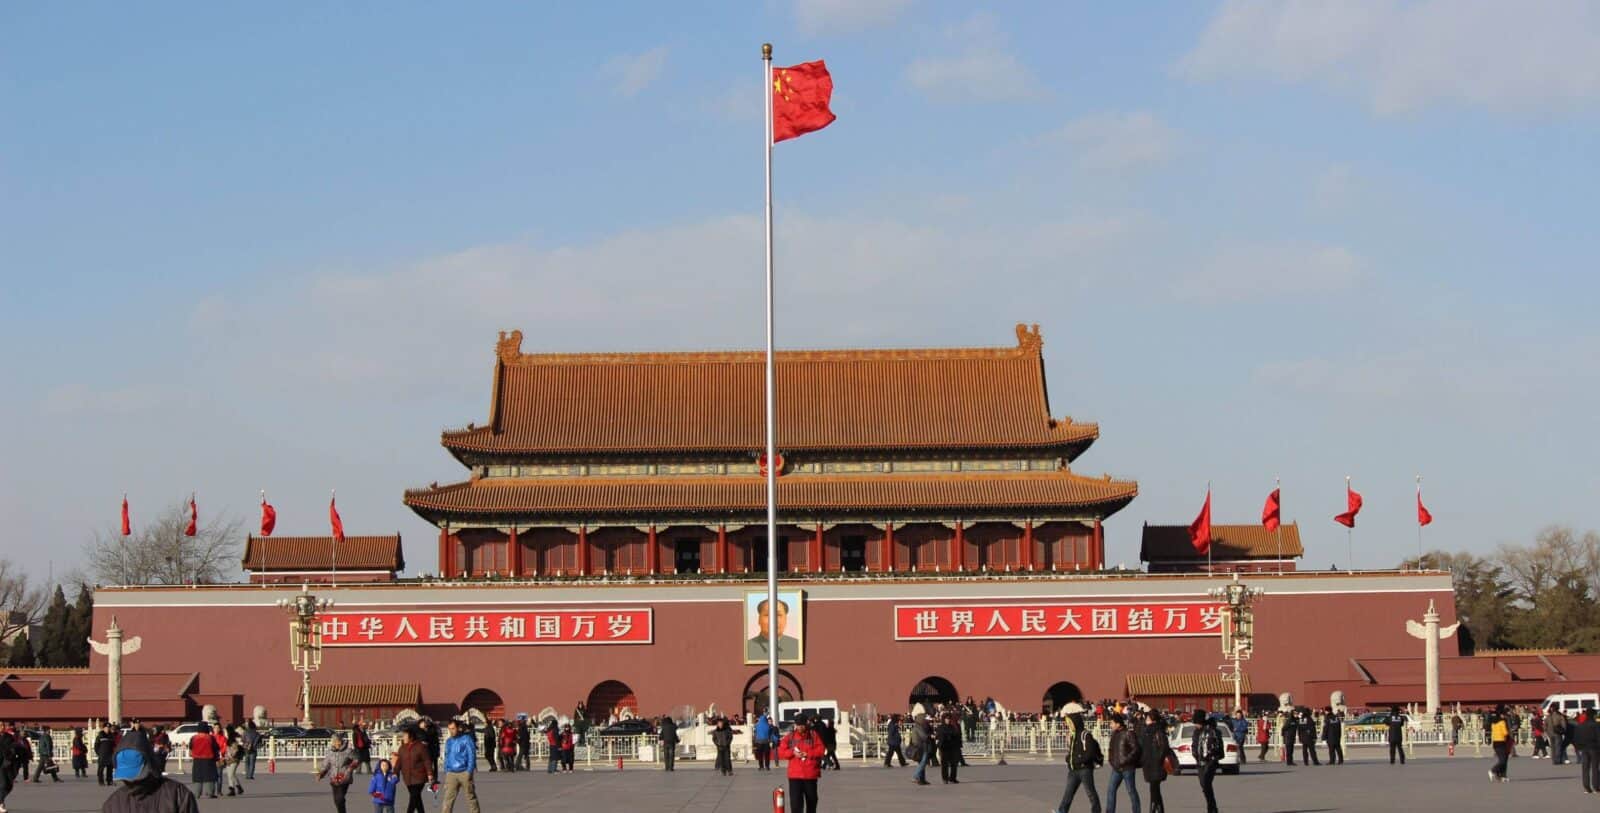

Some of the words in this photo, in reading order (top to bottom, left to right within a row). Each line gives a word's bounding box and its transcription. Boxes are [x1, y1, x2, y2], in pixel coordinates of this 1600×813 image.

[322, 615, 632, 640] 中华人民共和国万岁
[914, 607, 1223, 634] 世界人民大团结万岁
